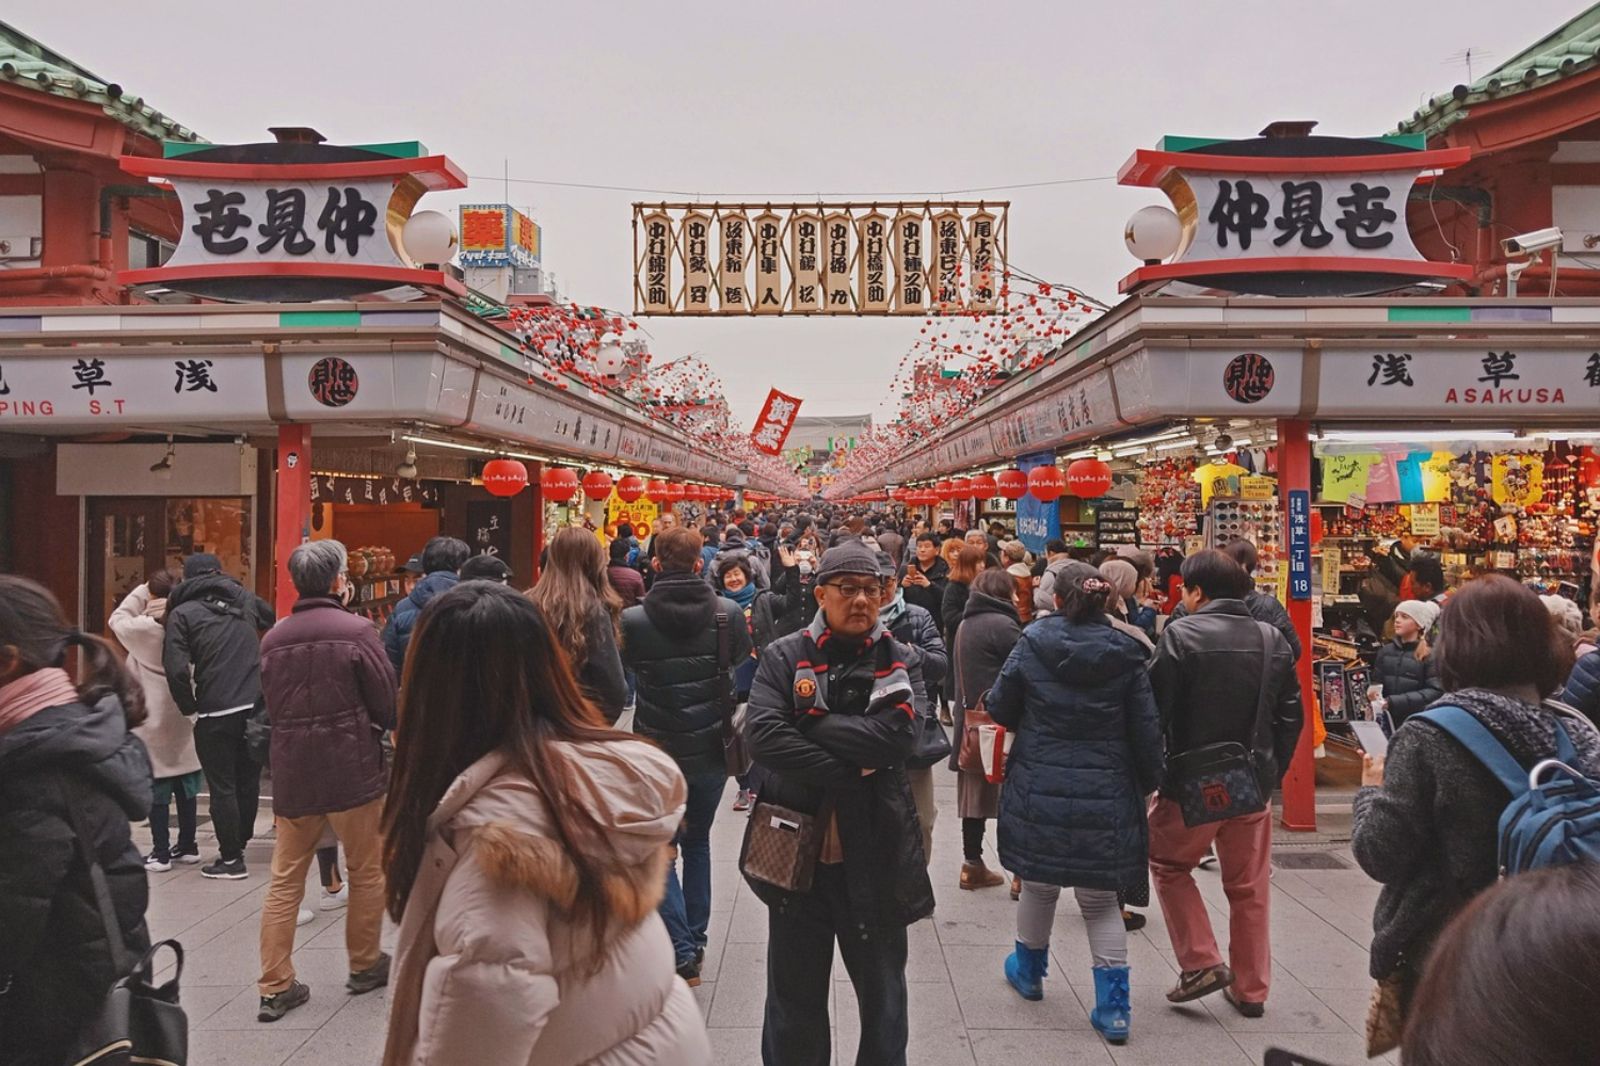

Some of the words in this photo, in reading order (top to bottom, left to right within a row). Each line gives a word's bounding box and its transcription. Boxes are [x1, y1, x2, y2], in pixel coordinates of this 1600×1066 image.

[463, 210, 503, 248] 薬
[1208, 180, 1397, 250] 仲見世
[1445, 387, 1566, 404] ASAKUSA
[1294, 513, 1305, 572] 浅草一丁目
[1294, 579, 1308, 593] 18
